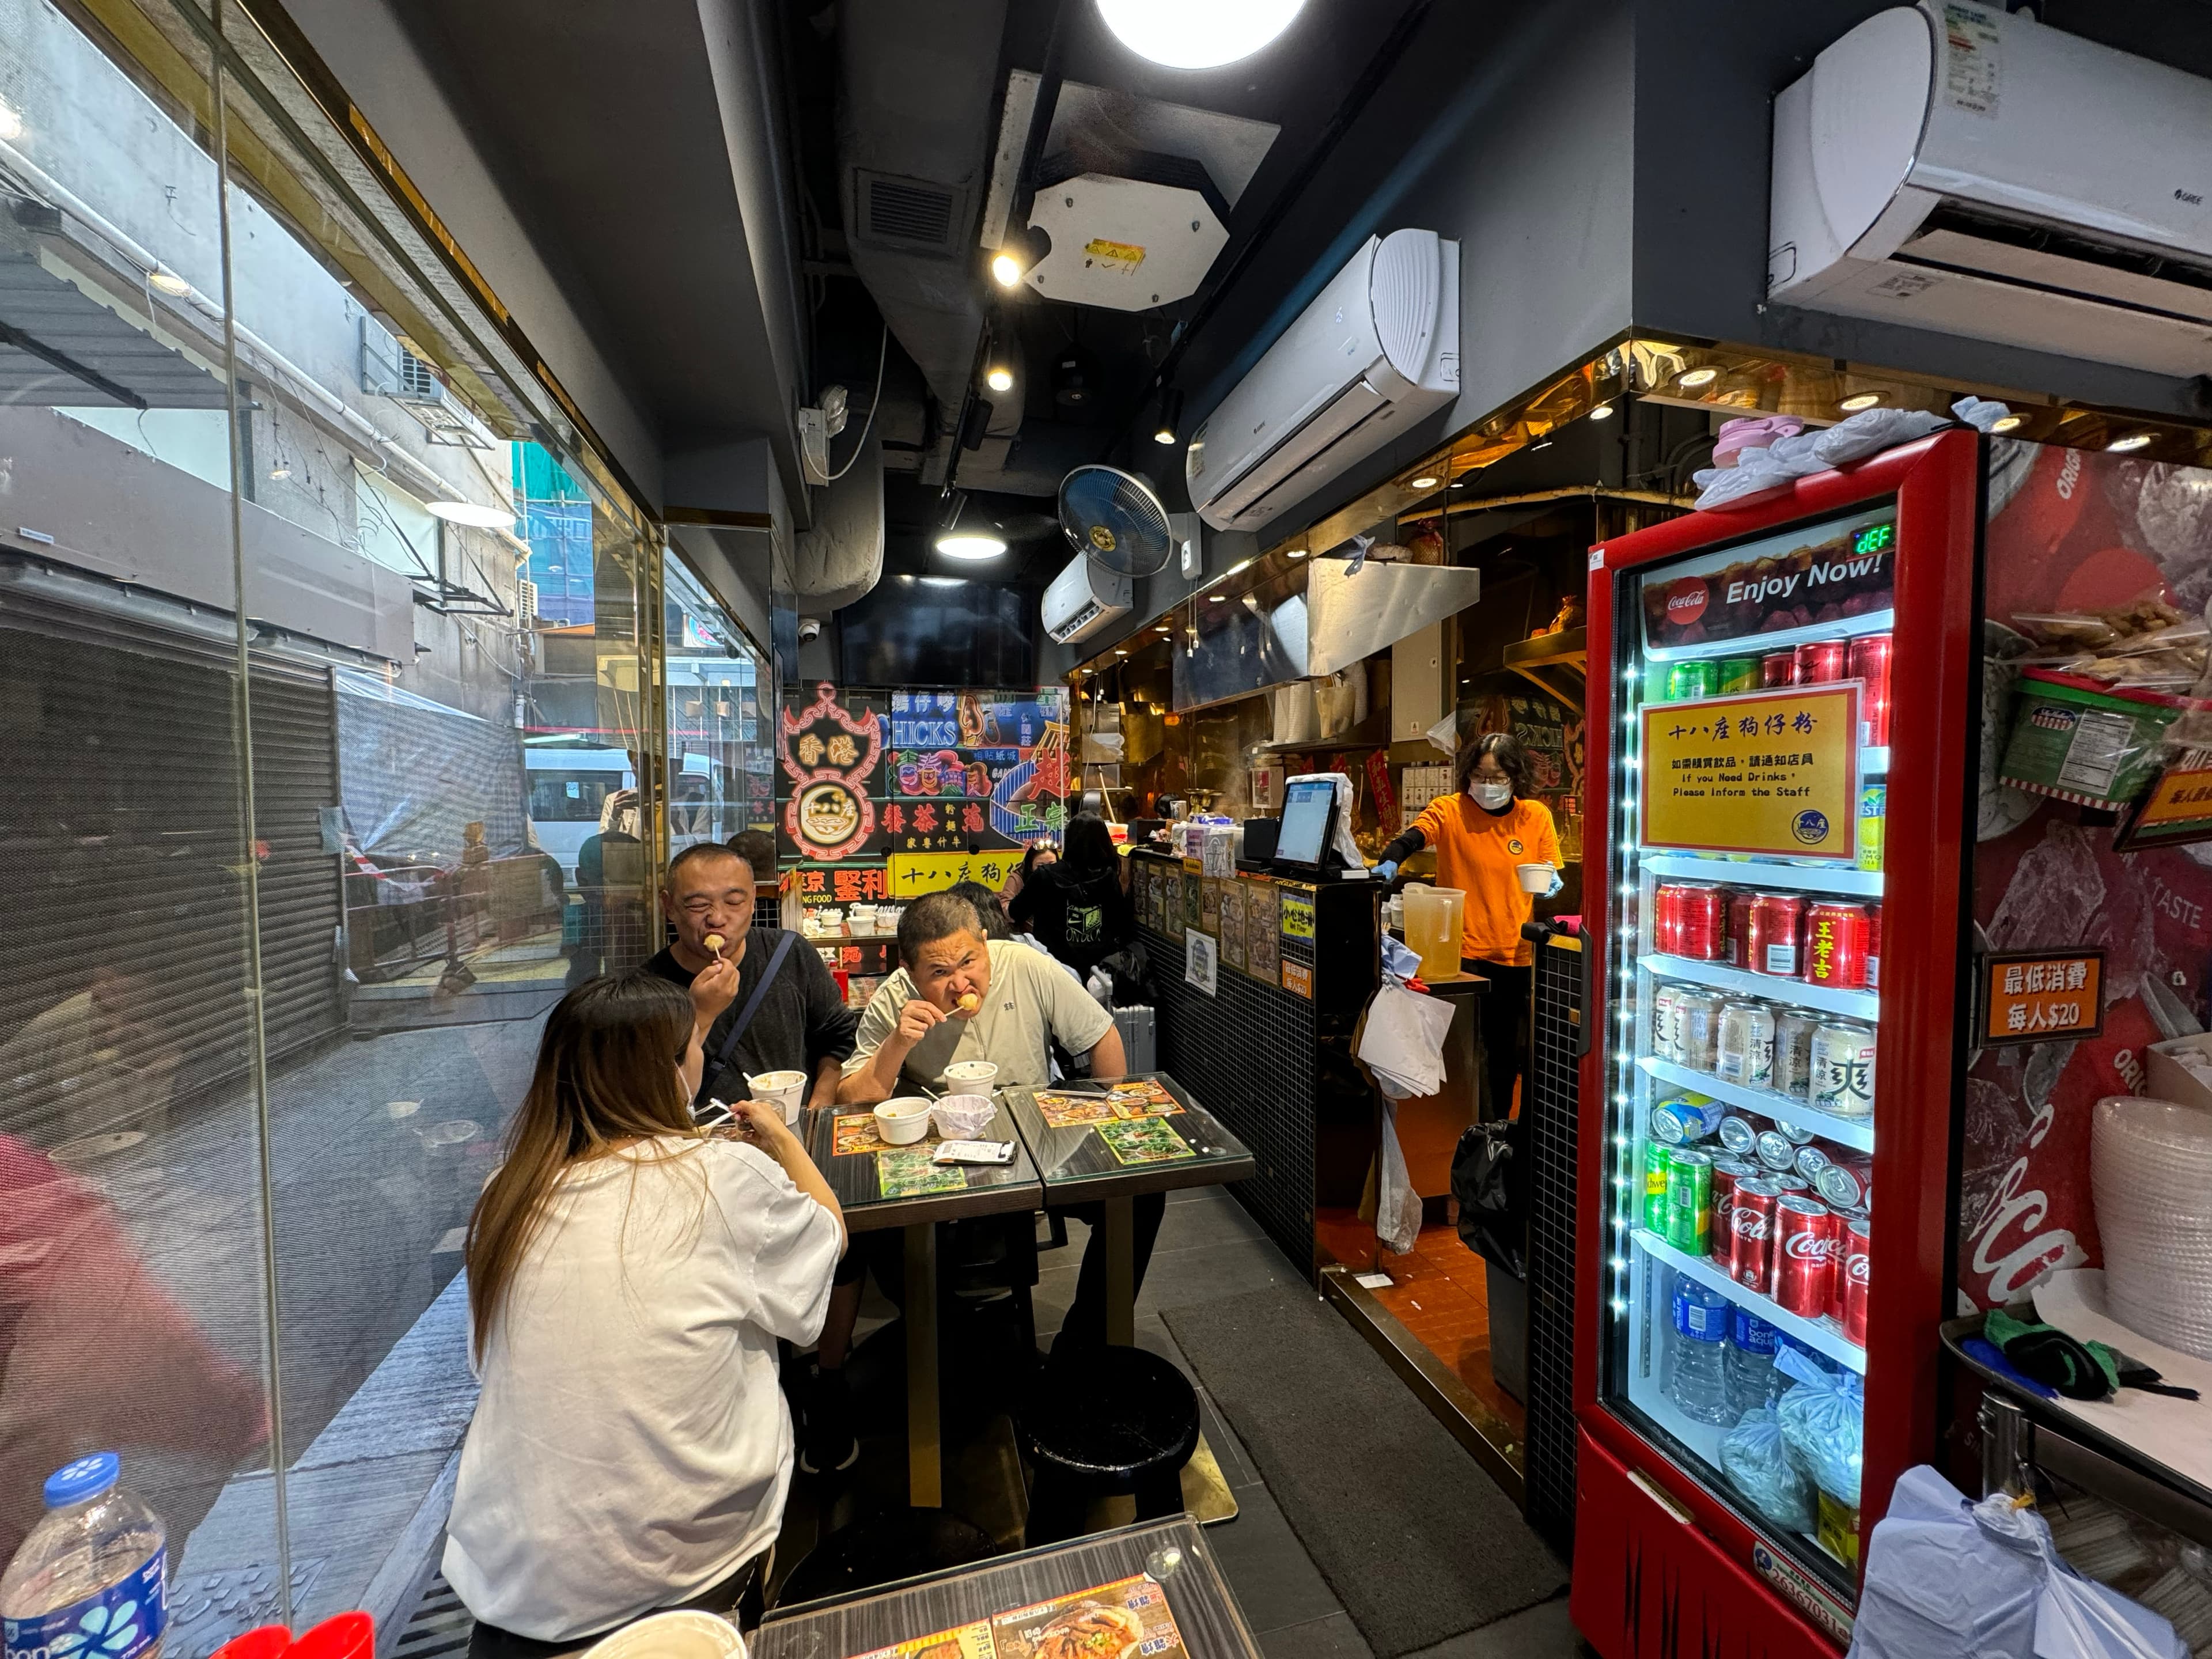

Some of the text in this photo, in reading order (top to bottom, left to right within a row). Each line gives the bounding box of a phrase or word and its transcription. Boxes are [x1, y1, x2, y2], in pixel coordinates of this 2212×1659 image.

[1726, 554, 1882, 605] Enjoy Now!
[1668, 589, 1706, 610] Coca-Cola
[1668, 711, 1817, 742] 十八座狗仔粉
[800, 734, 859, 766] 香港
[1673, 787, 1810, 796] Please Inform the Staff
[1682, 774, 1691, 782] If
[1697, 775, 1713, 783] you
[1719, 773, 1743, 782] Need
[1797, 818, 1827, 828] 十八座
[813, 895, 832, 903] FOOD
[2152, 877, 2203, 929] TASTE
[1813, 922, 1834, 979] 王老吉
[2004, 961, 2088, 995] 最低消費
[2007, 1002, 2081, 1031] 每人$20
